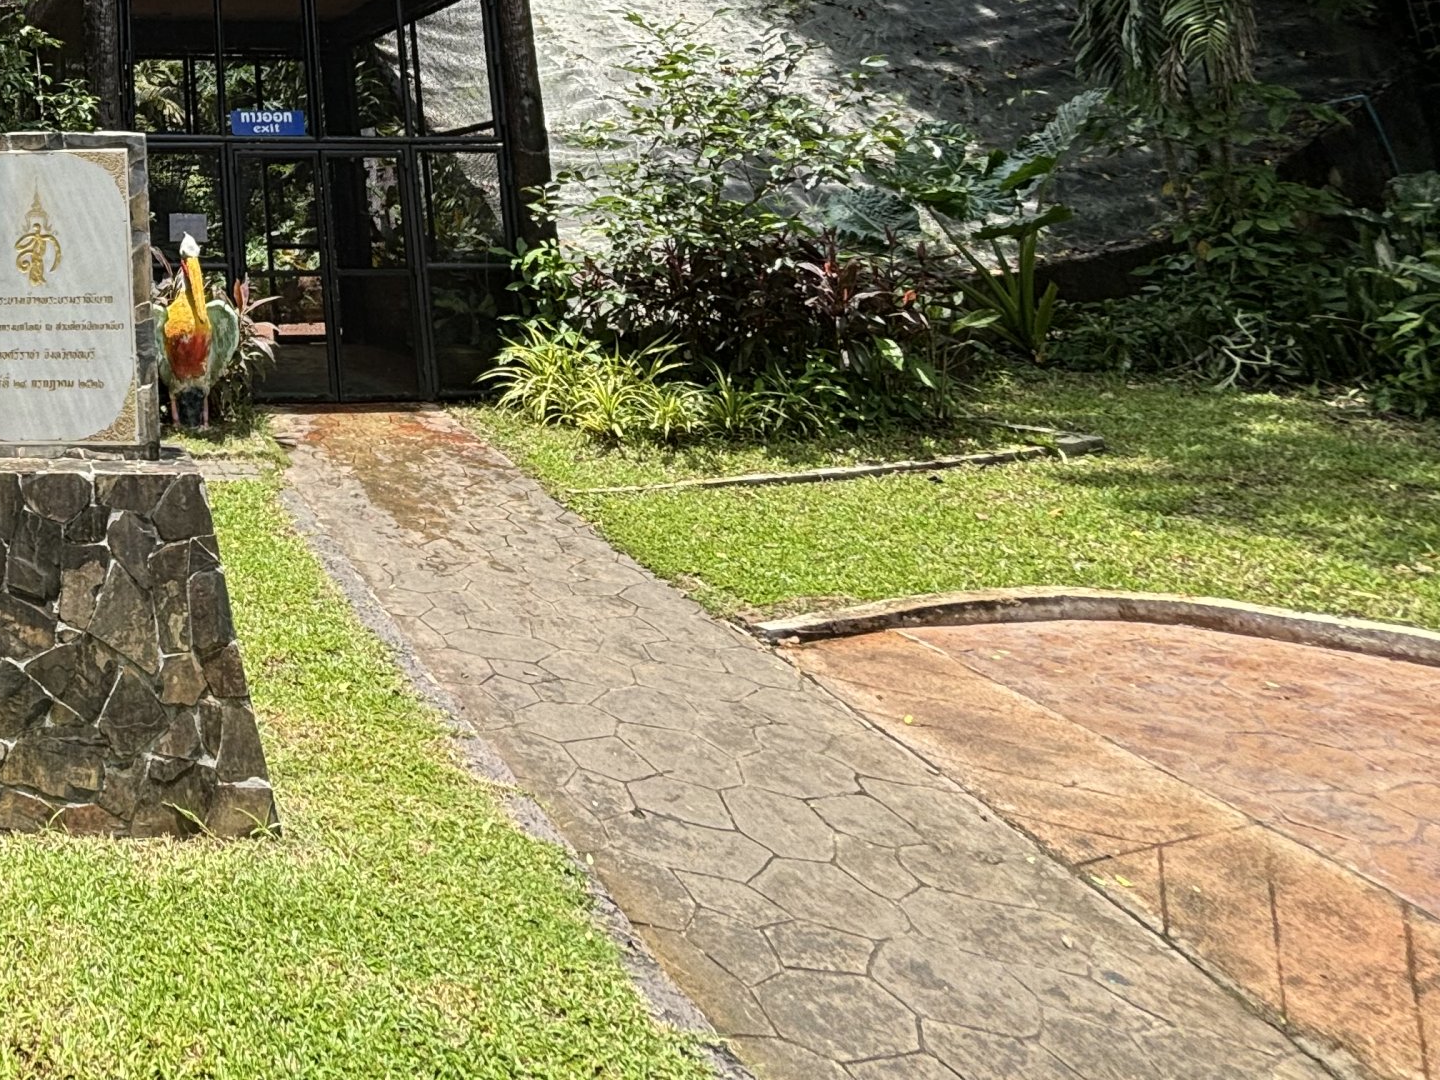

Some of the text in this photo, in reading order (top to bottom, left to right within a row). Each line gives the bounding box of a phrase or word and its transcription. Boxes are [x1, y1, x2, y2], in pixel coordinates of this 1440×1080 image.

[240, 111, 293, 123] ทางออก
[253, 123, 280, 133] exit
[32, 379, 75, 392] กรกฎาคม
